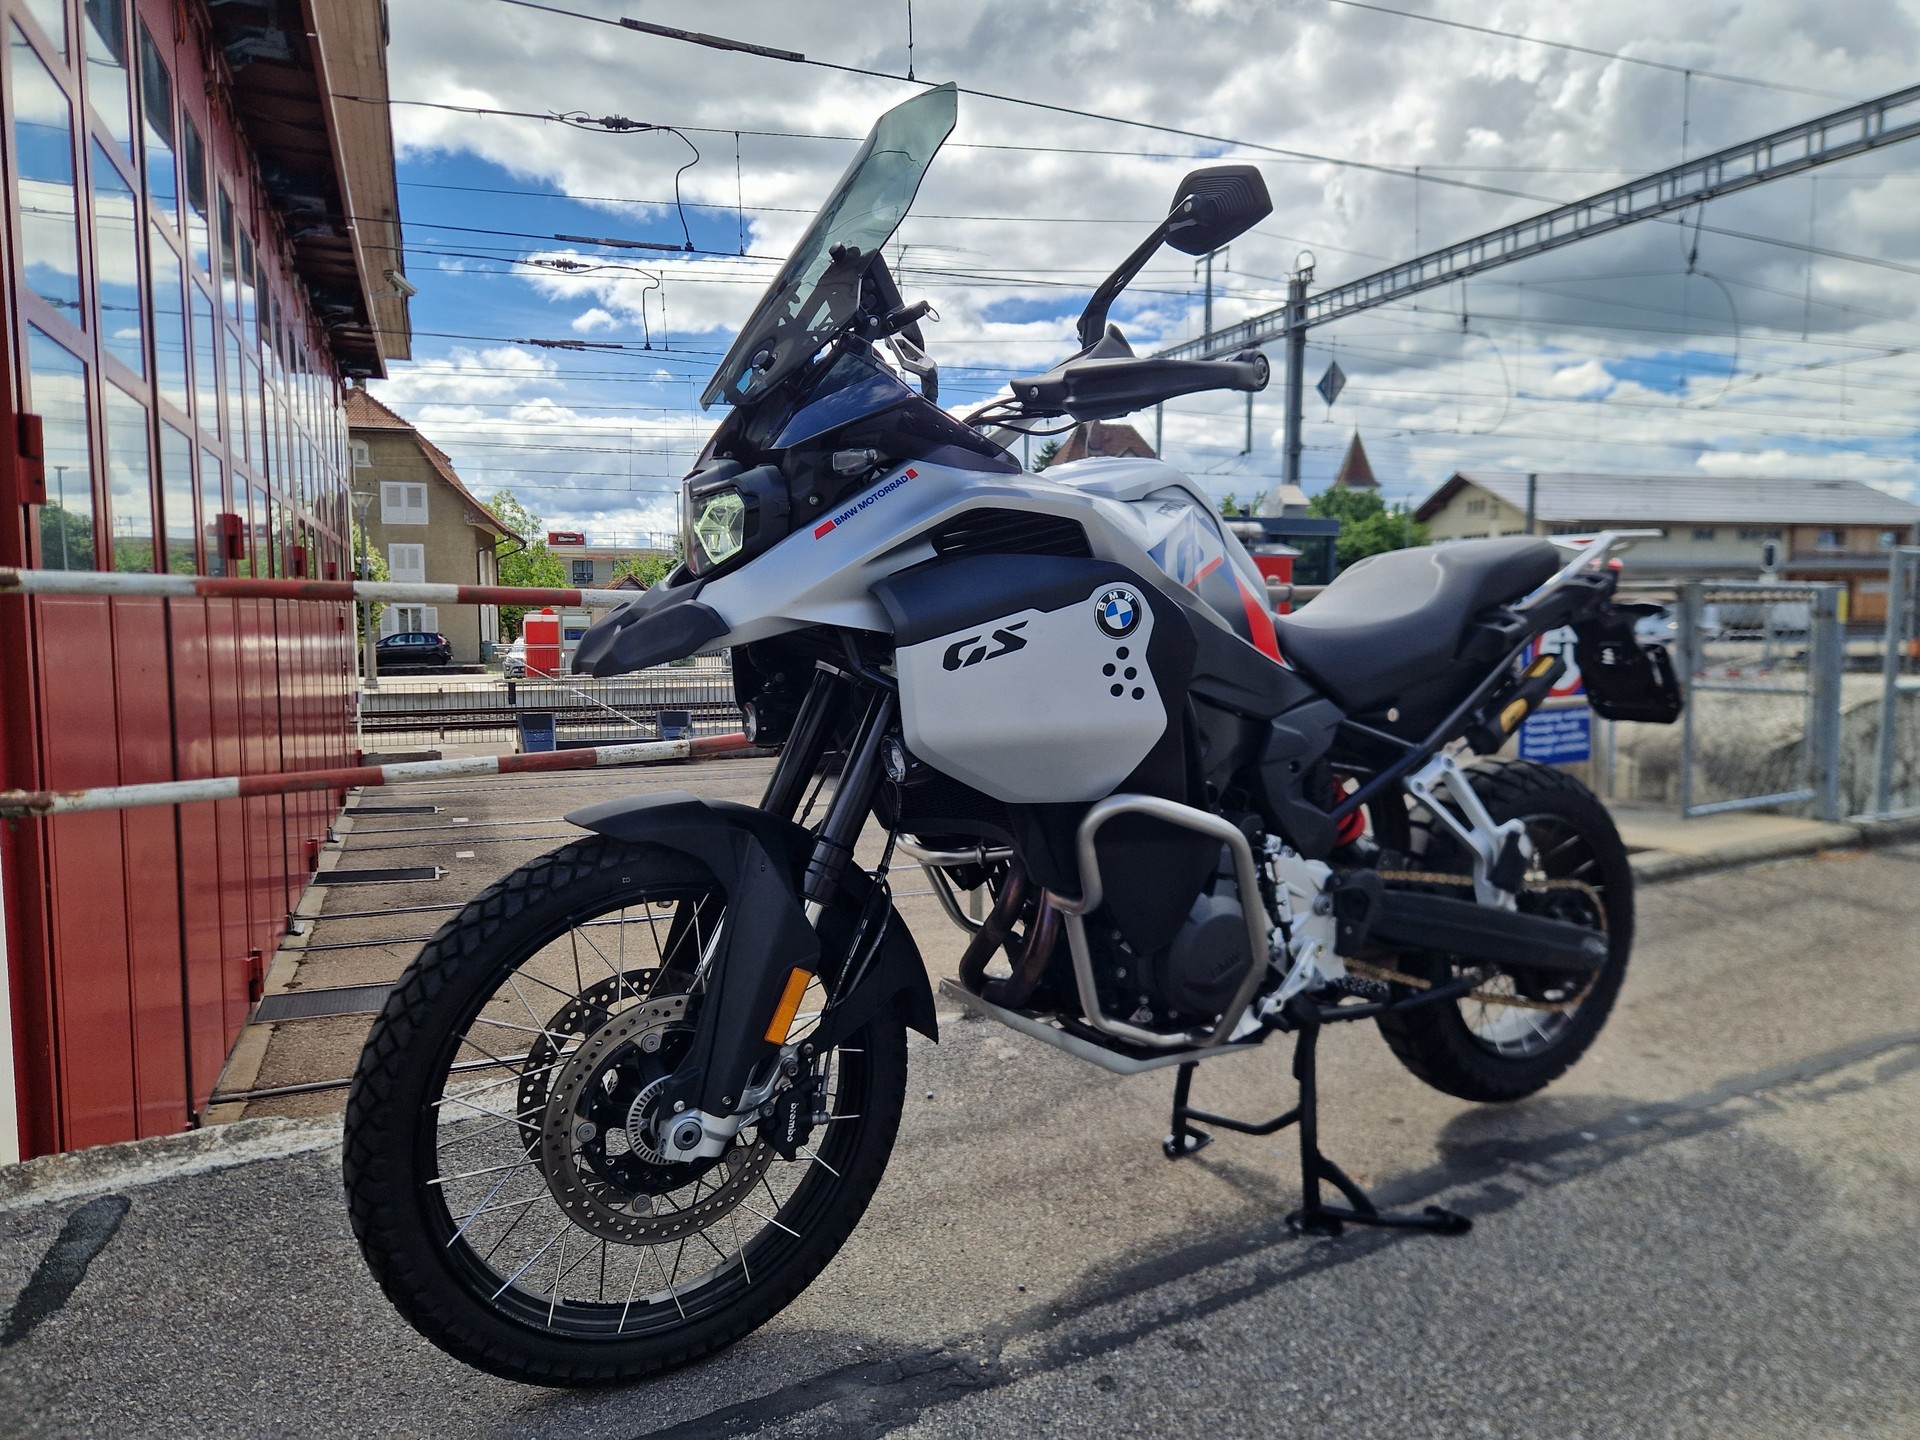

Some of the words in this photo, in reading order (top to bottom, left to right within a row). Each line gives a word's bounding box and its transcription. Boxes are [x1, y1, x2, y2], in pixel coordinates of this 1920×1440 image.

[834, 507, 858, 526] BMW
[858, 475, 909, 510] MOTORRAD
[943, 620, 1029, 671] GS
[787, 1103, 799, 1142] brembo
